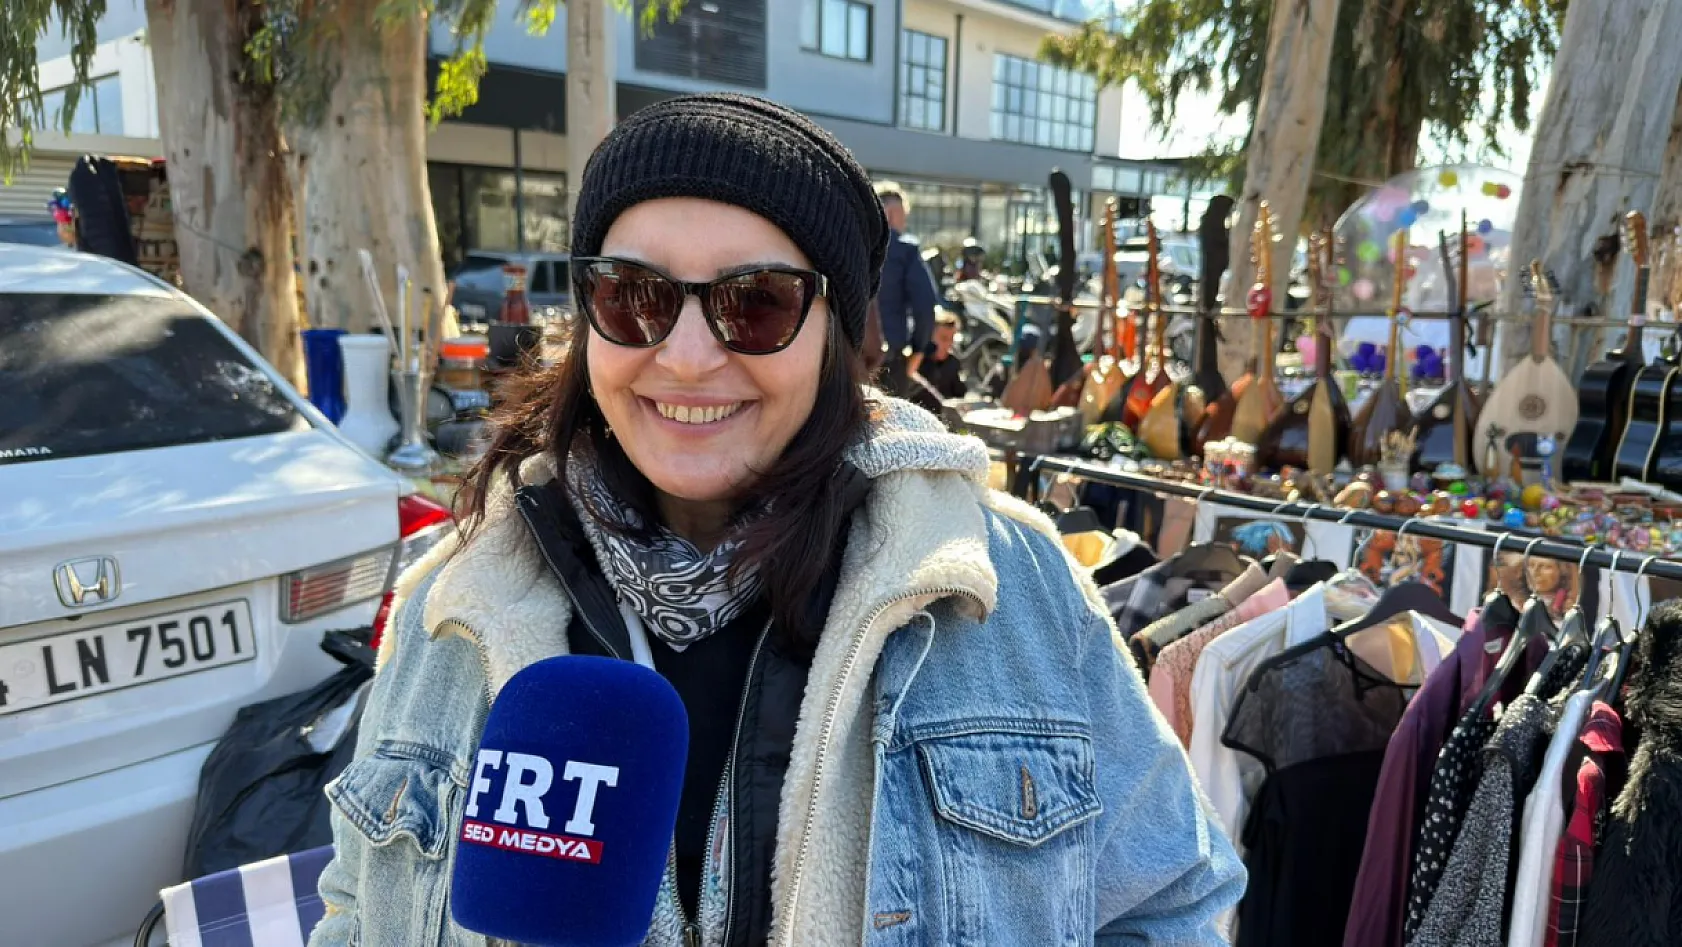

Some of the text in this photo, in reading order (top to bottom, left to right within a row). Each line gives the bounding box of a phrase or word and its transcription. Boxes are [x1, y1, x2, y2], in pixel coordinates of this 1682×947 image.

[42, 635, 110, 695] LN
[127, 609, 241, 678] 7501
[466, 749, 619, 835] FRT
[465, 824, 591, 859] SED MEDYA
